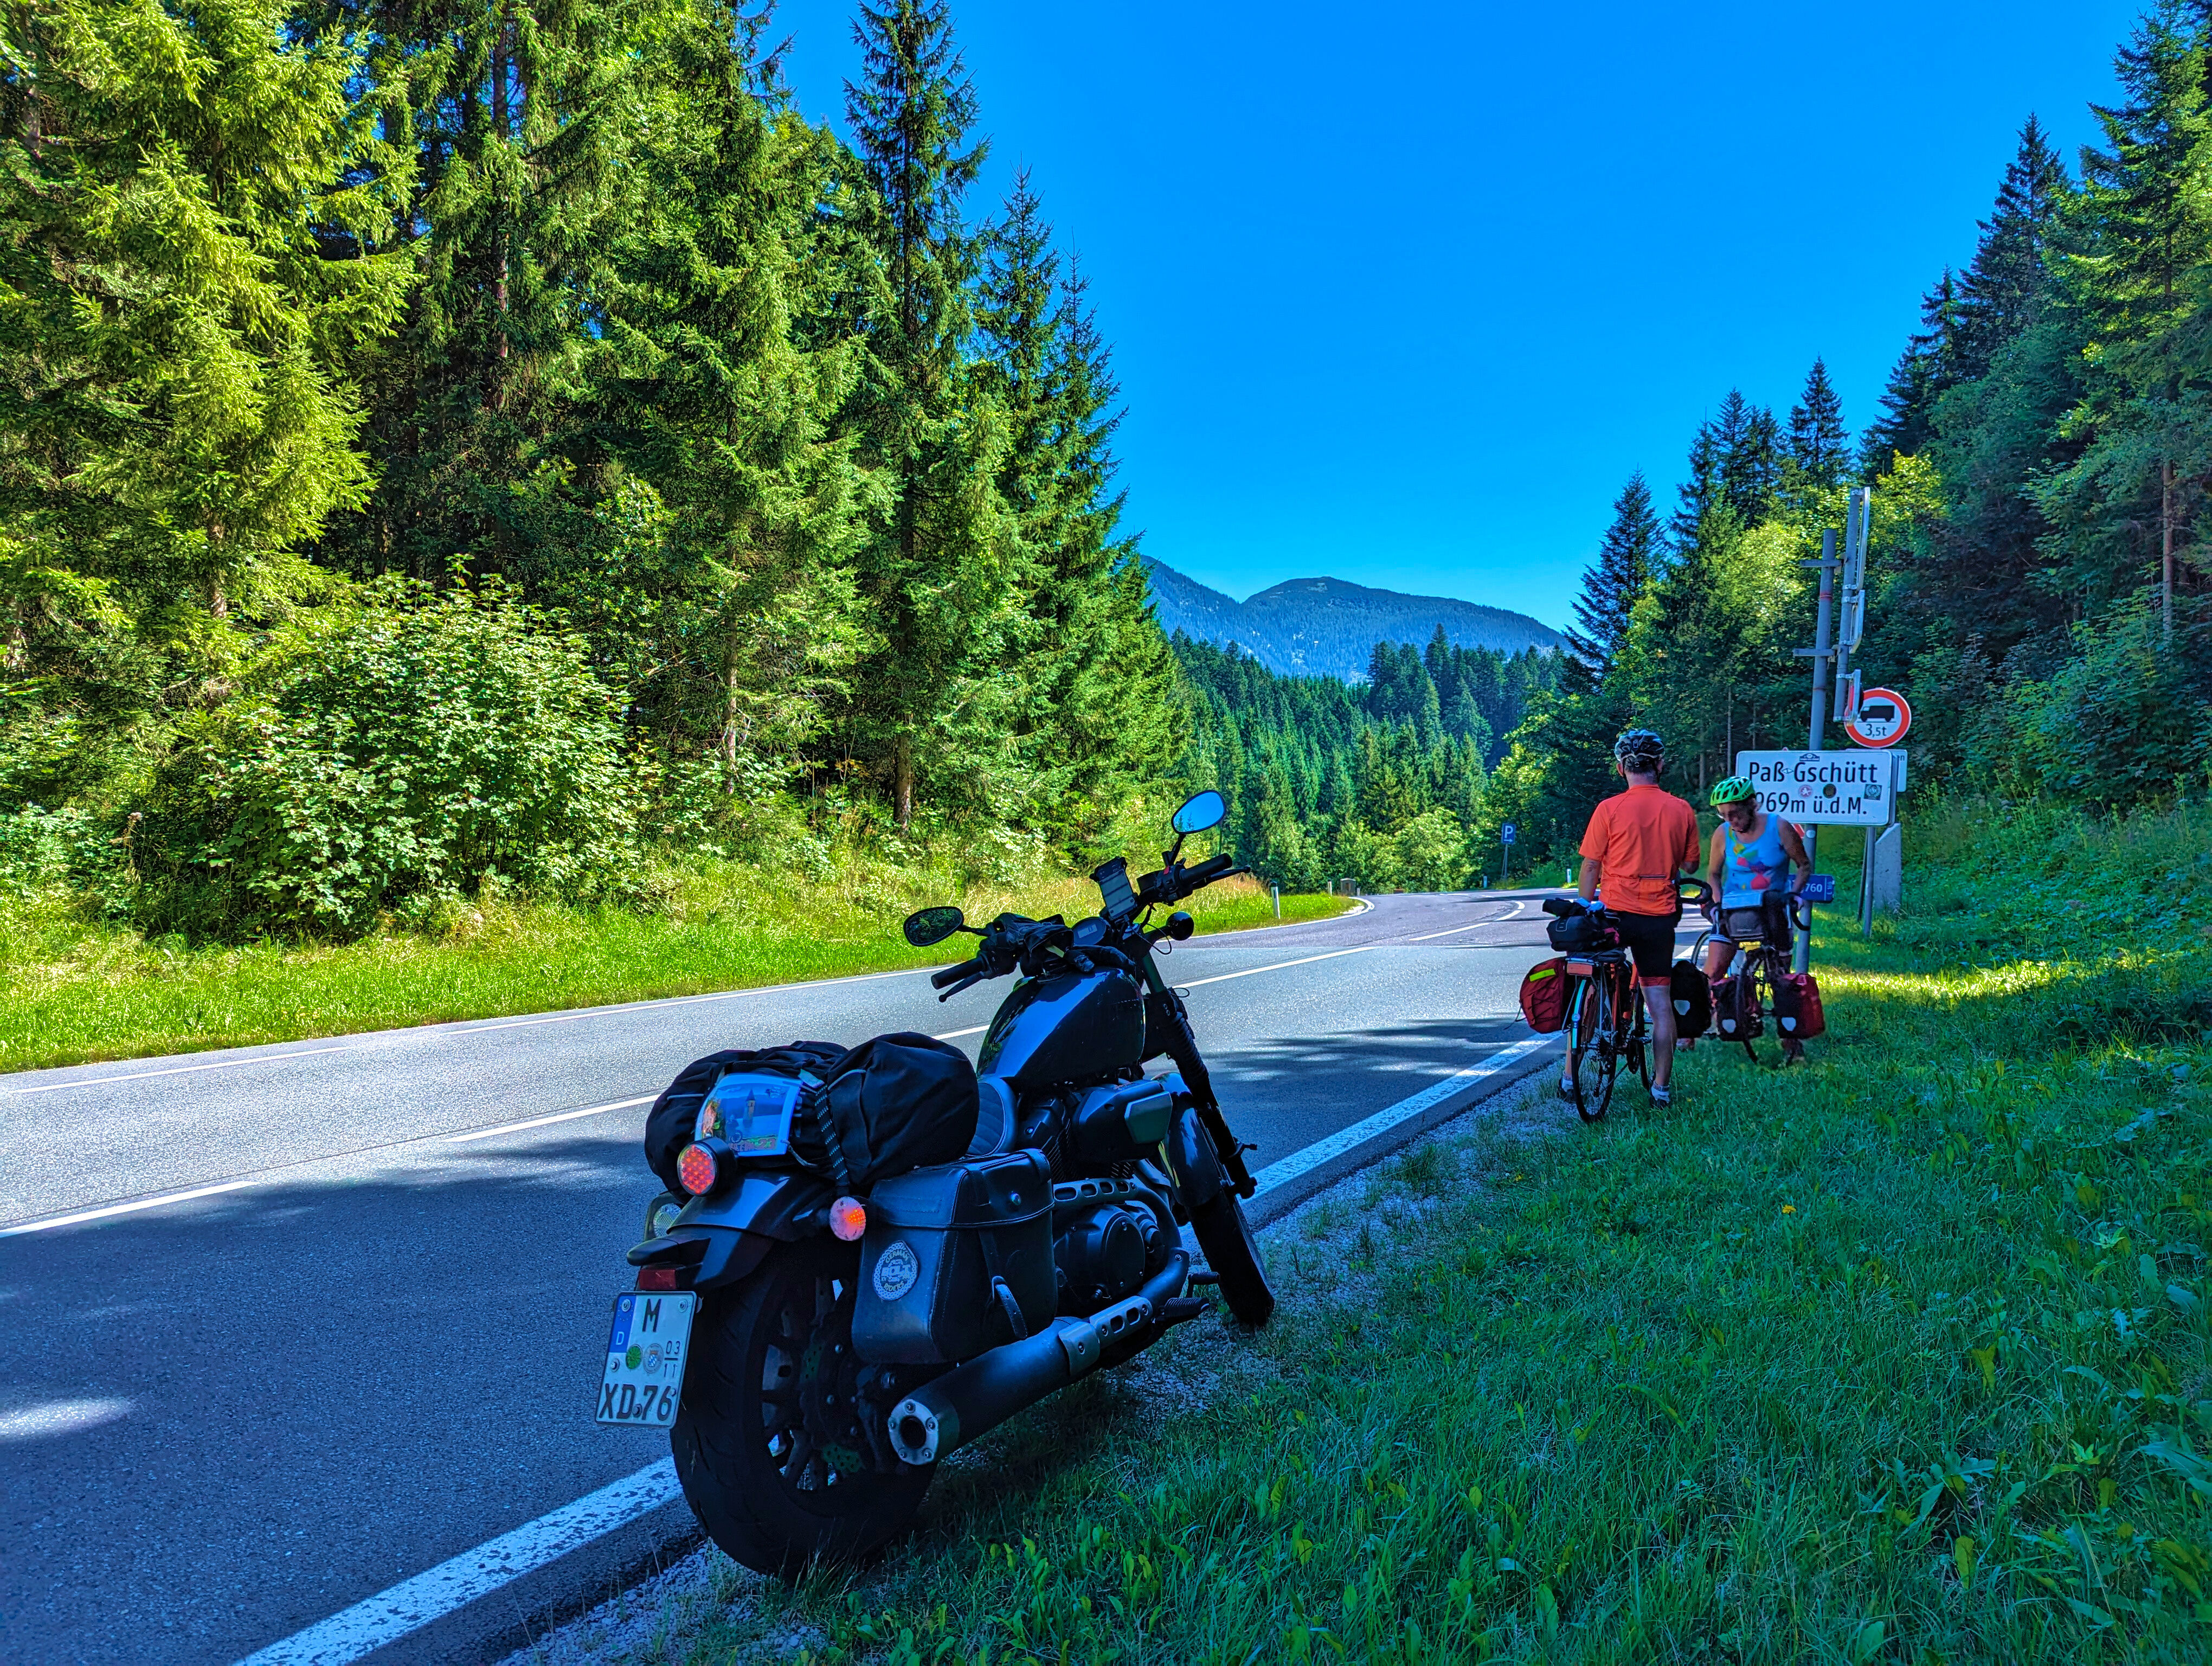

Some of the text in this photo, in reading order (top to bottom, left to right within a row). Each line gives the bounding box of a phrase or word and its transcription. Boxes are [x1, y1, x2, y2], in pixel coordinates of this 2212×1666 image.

[1865, 723, 1887, 738] 3,5t
[1749, 761, 1877, 783] Paß Gschütt
[1814, 796, 1867, 815] ü.d.M.
[1504, 825, 1513, 838] P
[882, 1264, 911, 1277] BOLT
[884, 1281, 904, 1292] RIDERS
[642, 1298, 662, 1332] M
[616, 1331, 625, 1345] D
[666, 1340, 681, 1355] 03
